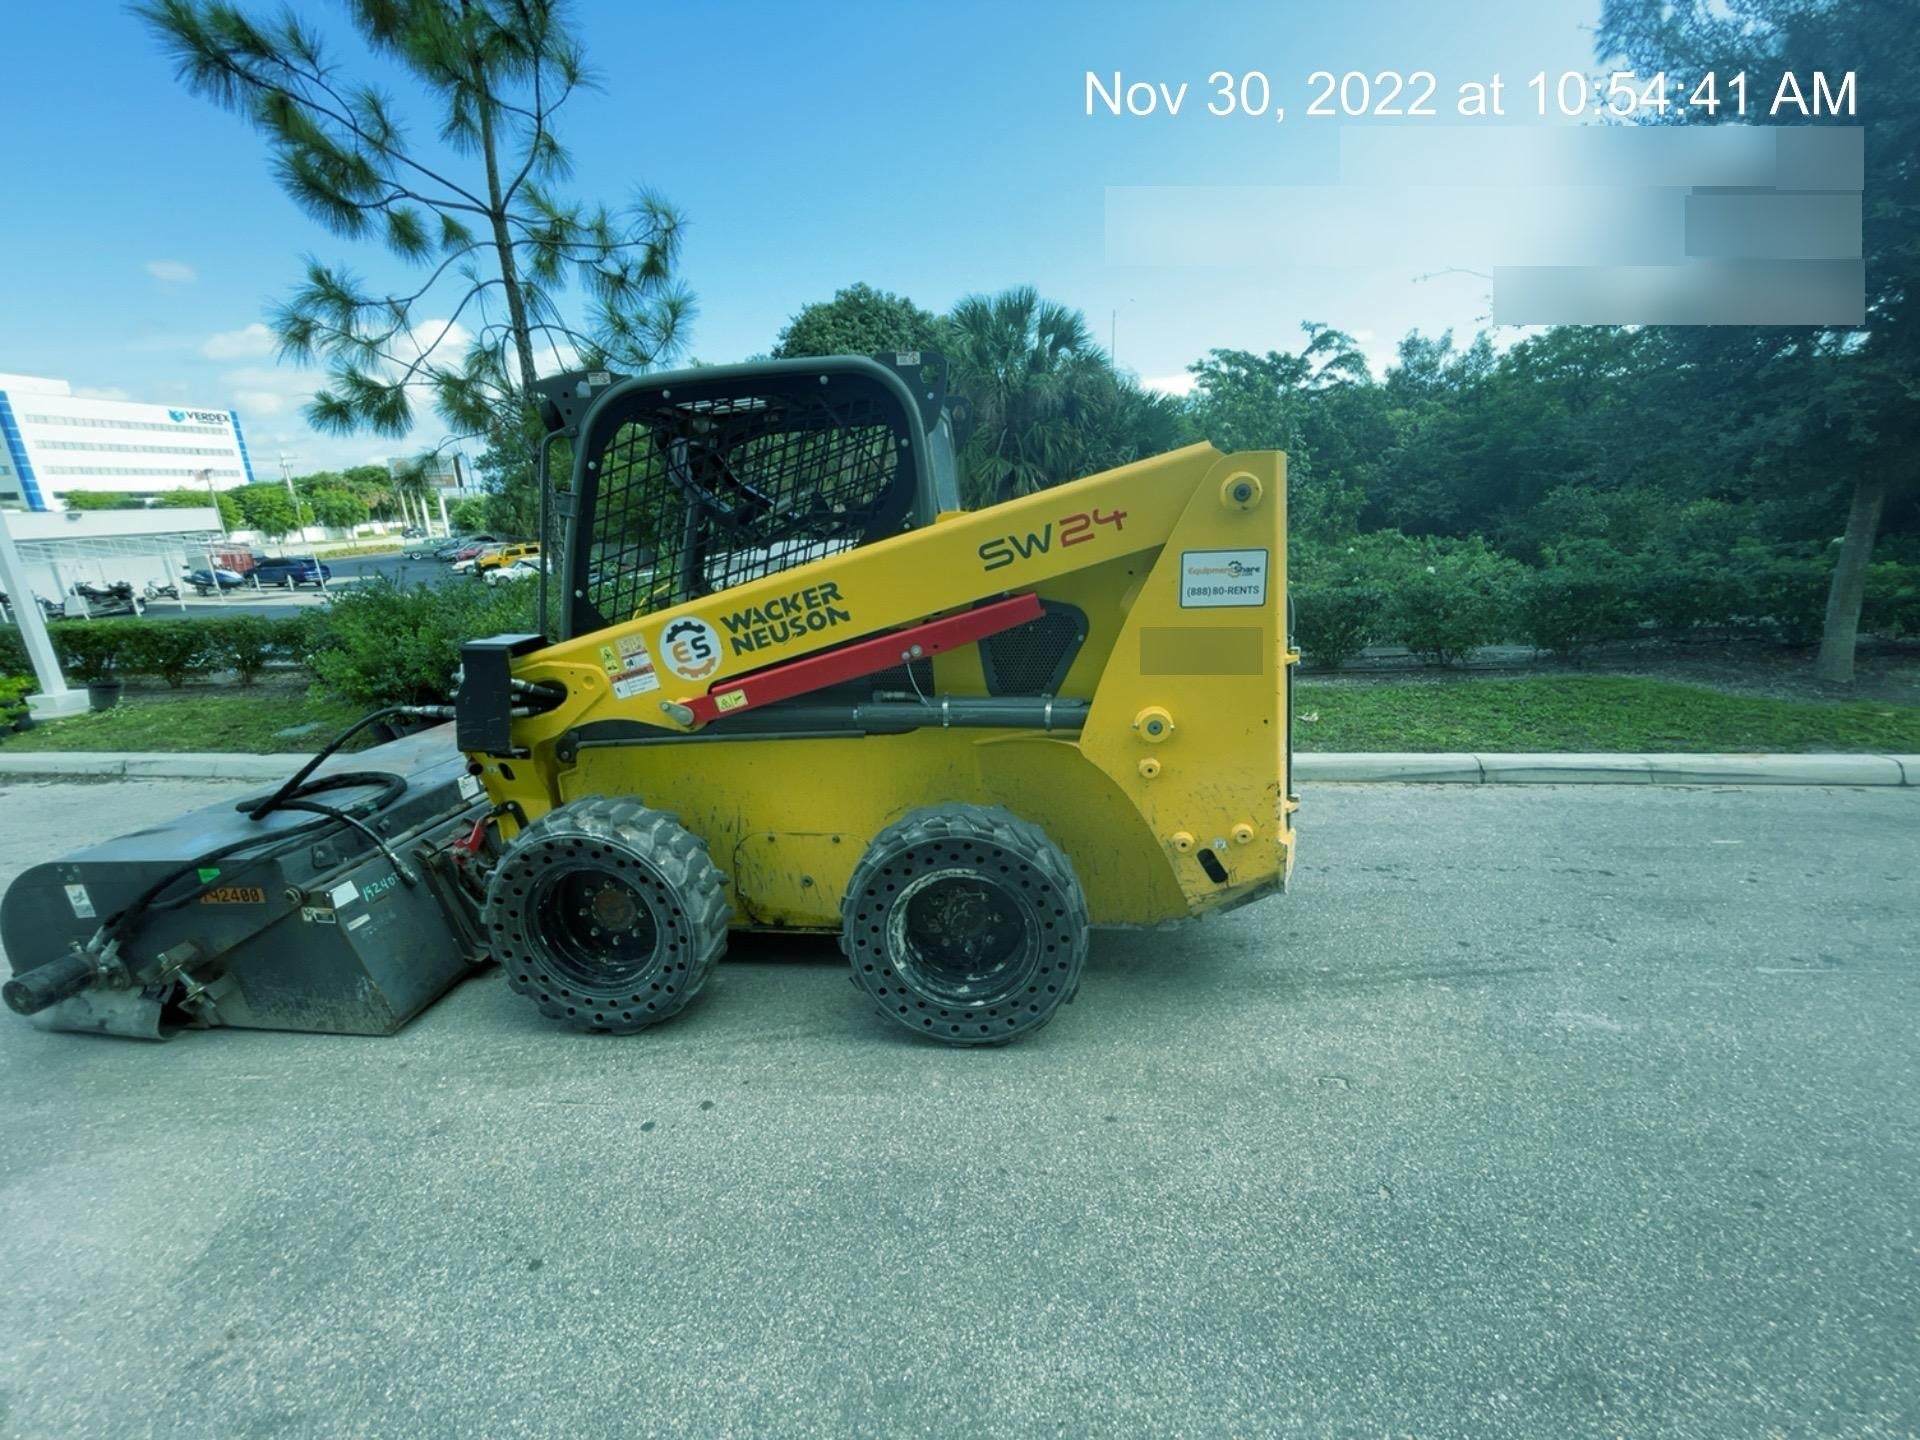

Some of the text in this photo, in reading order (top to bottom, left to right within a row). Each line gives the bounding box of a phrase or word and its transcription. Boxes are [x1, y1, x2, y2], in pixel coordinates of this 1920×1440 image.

[185, 411, 230, 422] VERDEX
[720, 582, 844, 634] WACKER
[673, 635, 712, 662] ES
[730, 605, 851, 656] NEUSON
